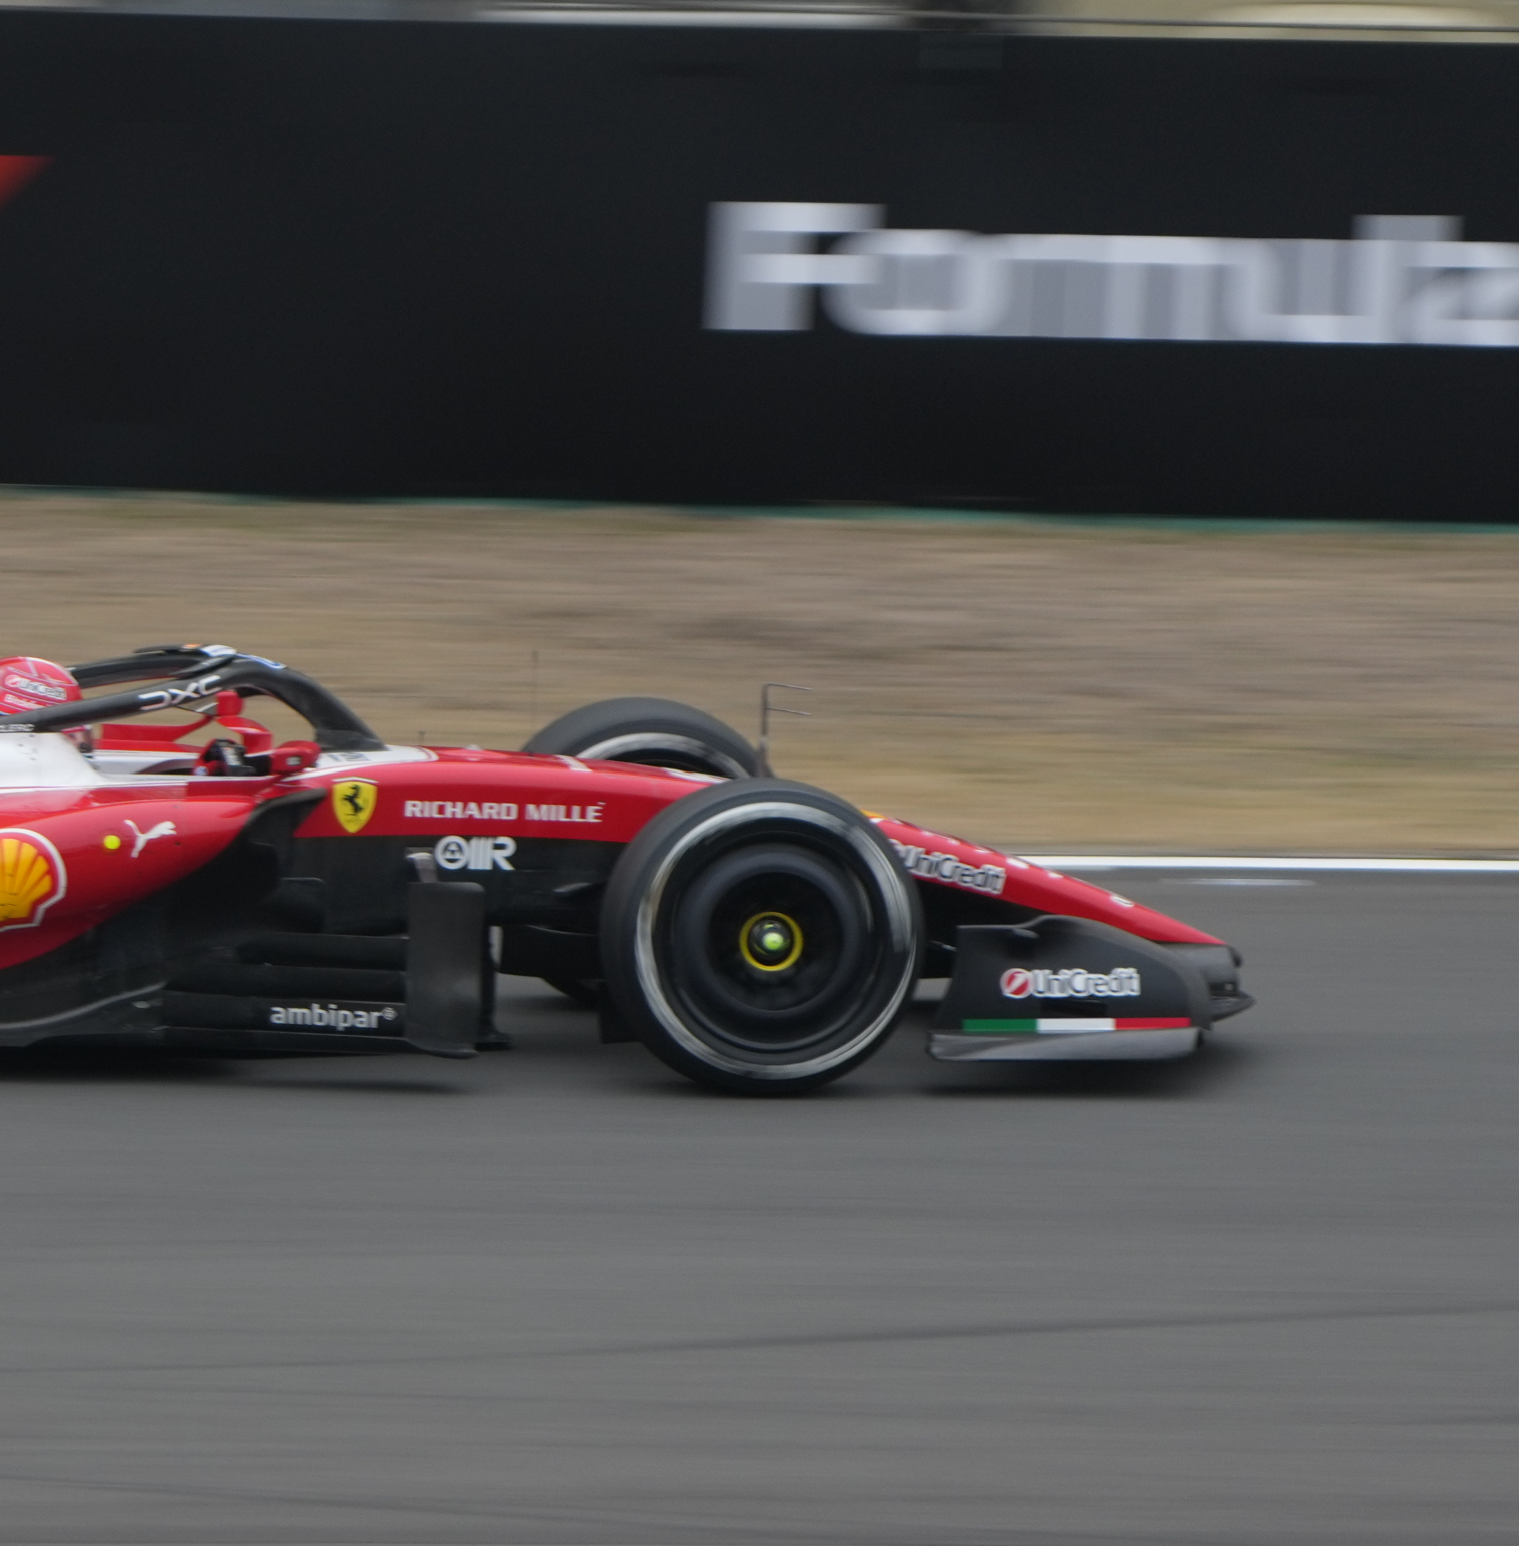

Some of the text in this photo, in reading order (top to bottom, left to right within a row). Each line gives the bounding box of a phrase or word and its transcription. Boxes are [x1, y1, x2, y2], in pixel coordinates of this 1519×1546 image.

[138, 675, 222, 711] DXC
[404, 800, 604, 823] RICHARD MILLE
[903, 846, 1007, 894] UniCredit
[1032, 968, 1141, 997] UniCredit
